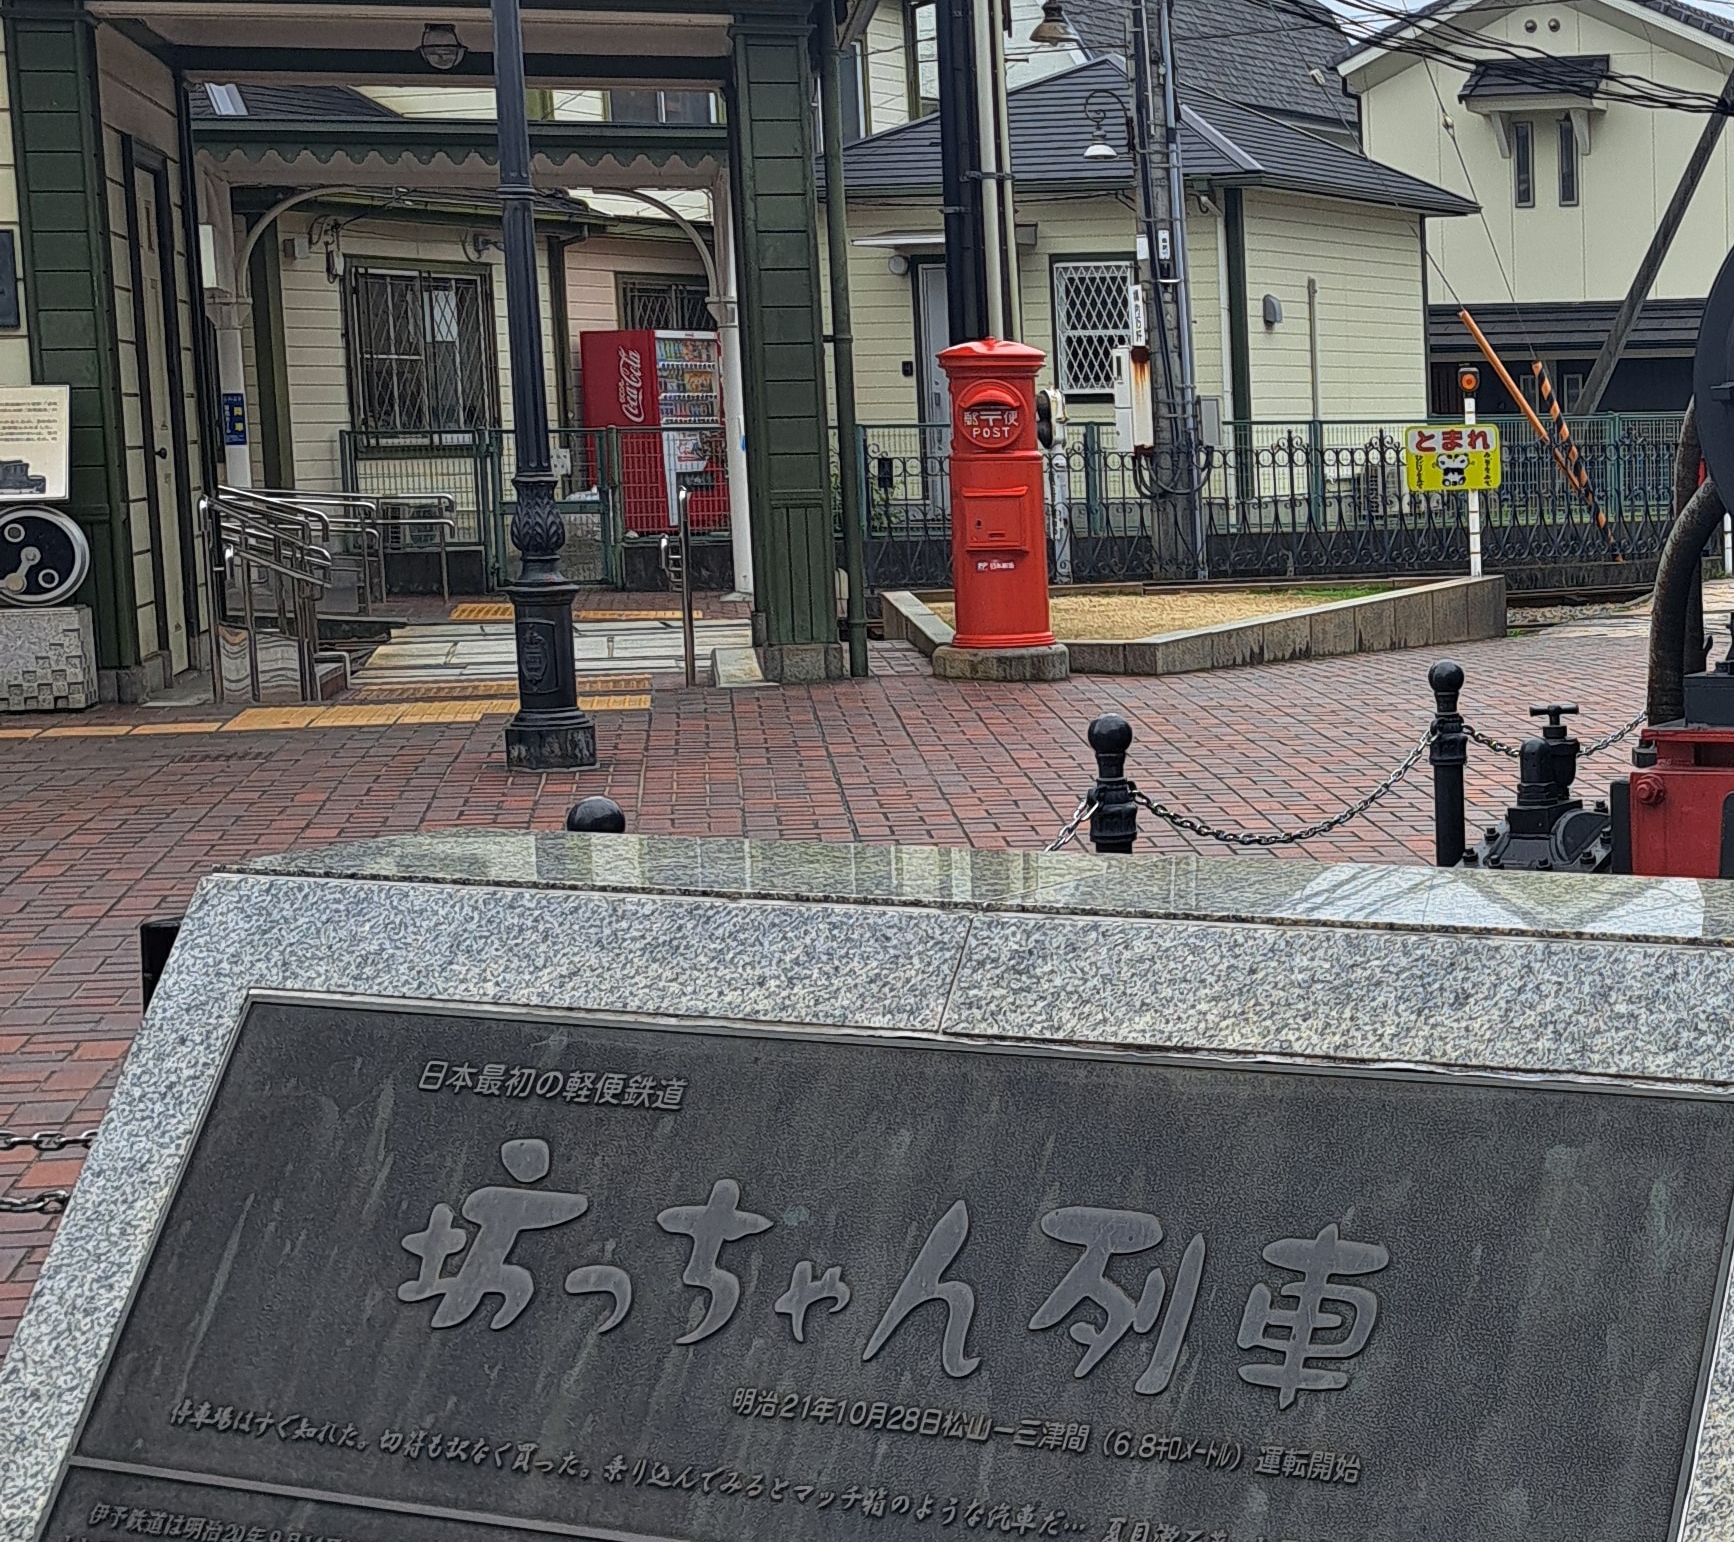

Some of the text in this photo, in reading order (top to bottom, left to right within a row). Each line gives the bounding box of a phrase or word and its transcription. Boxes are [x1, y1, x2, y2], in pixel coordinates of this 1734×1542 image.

[972, 426, 1011, 439] POST
[1415, 428, 1491, 453] とまれ
[413, 1059, 690, 1112] 日本最初の軽便鉄道
[397, 1137, 1390, 1411] 坊っちゃん列車
